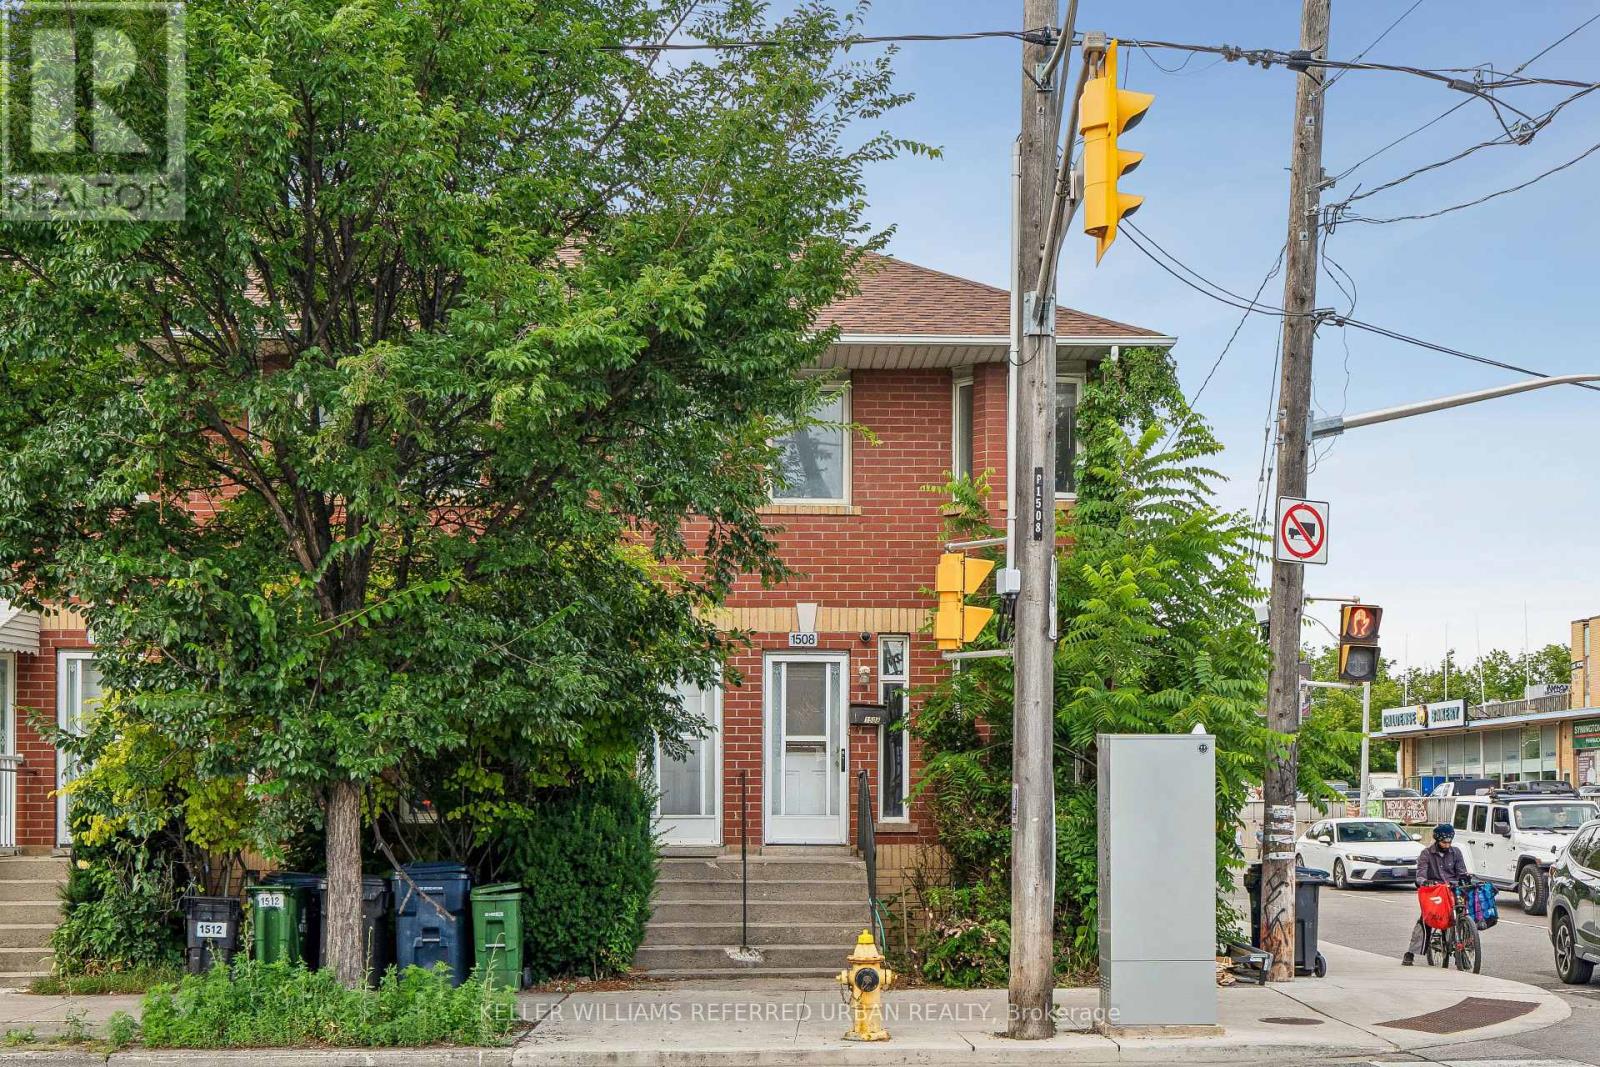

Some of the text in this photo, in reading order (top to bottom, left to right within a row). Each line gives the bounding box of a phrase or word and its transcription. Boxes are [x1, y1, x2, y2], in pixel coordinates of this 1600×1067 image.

[790, 634, 815, 645] 1508
[260, 896, 280, 906] 1512
[199, 925, 222, 934] 1512
